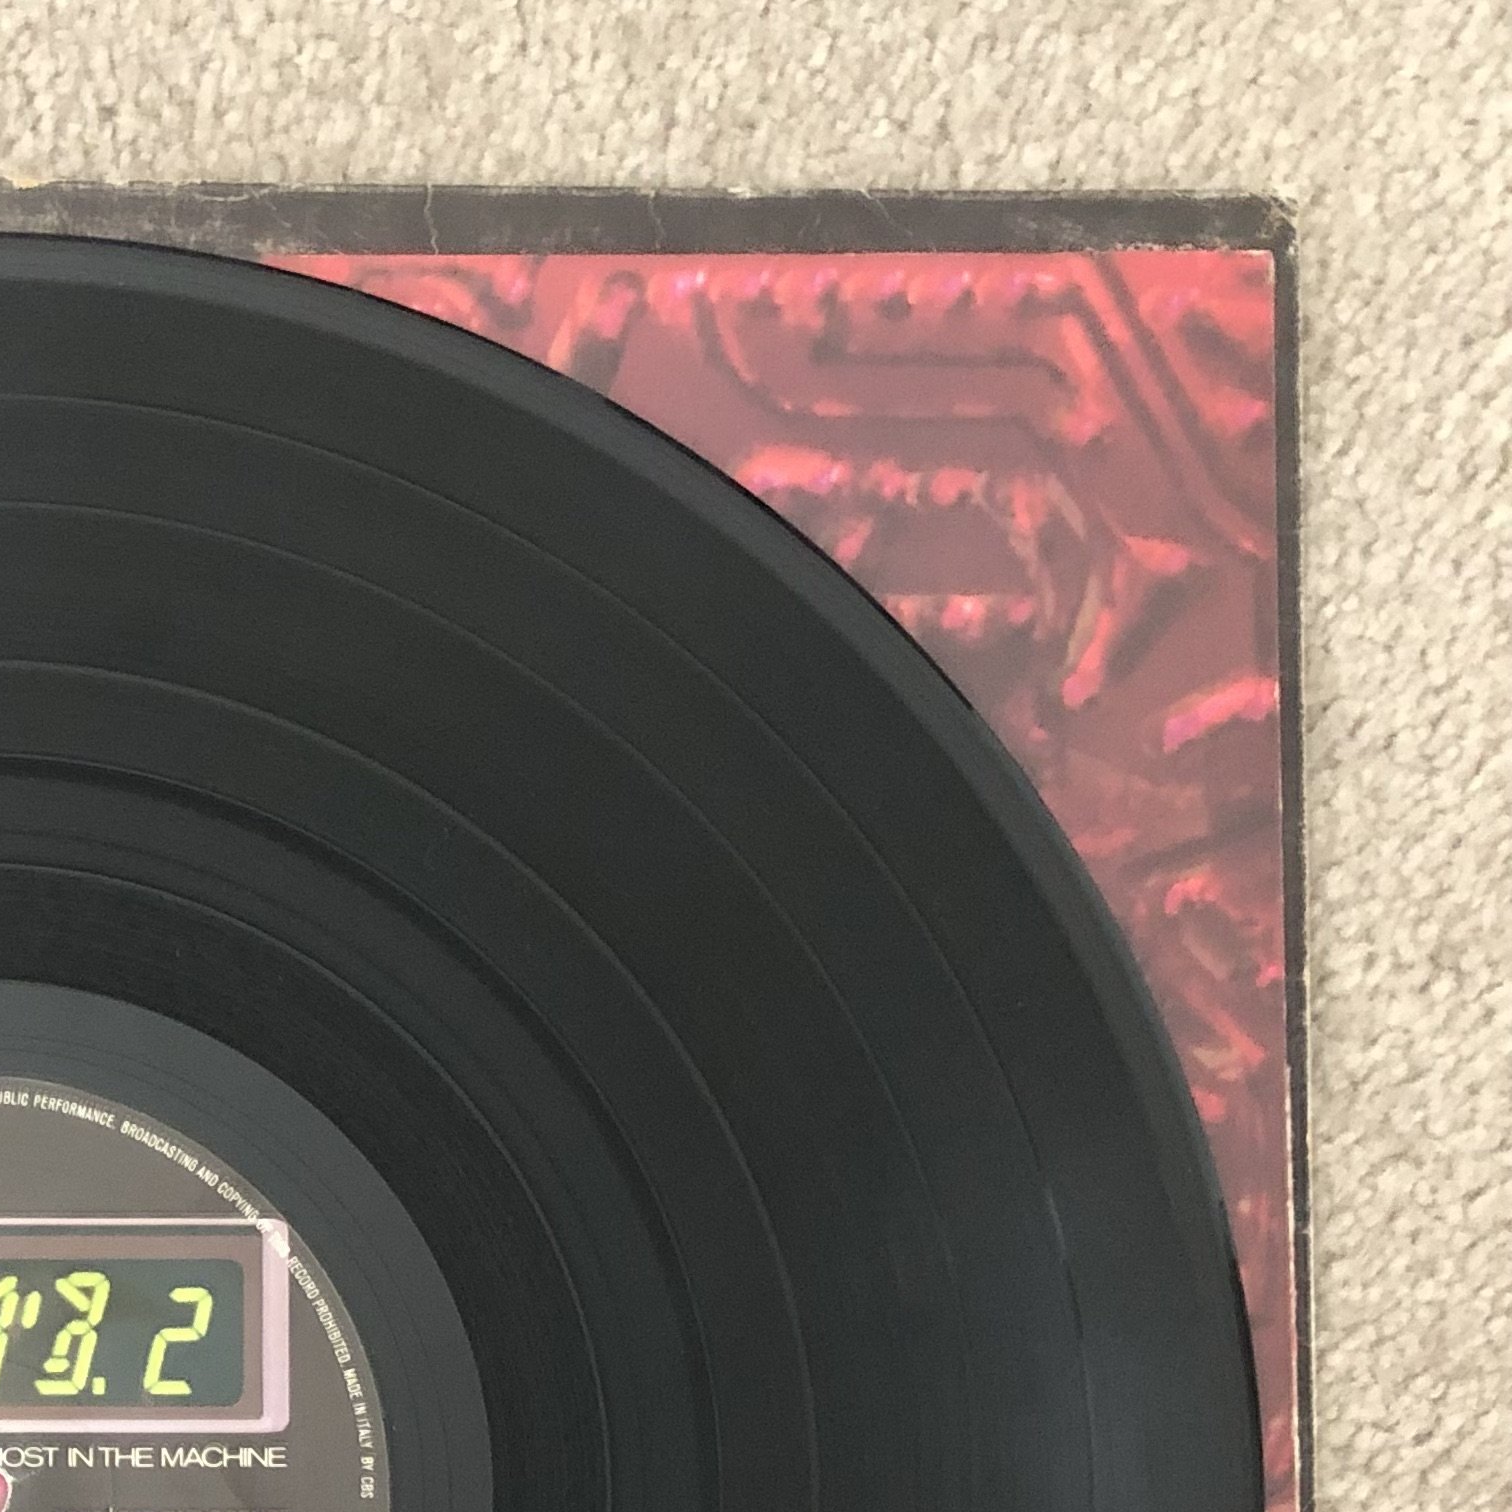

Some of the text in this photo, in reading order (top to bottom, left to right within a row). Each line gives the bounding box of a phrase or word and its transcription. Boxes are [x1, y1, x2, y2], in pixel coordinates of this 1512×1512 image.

[120, 1120, 199, 1173] BROADCASTING
[196, 1165, 219, 1187] AND
[217, 1181, 261, 1223] COPYING
[288, 1256, 320, 1300] RECORD
[341, 1367, 363, 1400] MADE
[352, 1402, 367, 1416] IN
[356, 1413, 374, 1448] ITALY
[68, 1447, 94, 1468] IN
[97, 1447, 155, 1468] THE
[161, 1447, 288, 1468] MACHINE
[360, 1456, 374, 1472] BY
[360, 1476, 375, 1499] CBS
